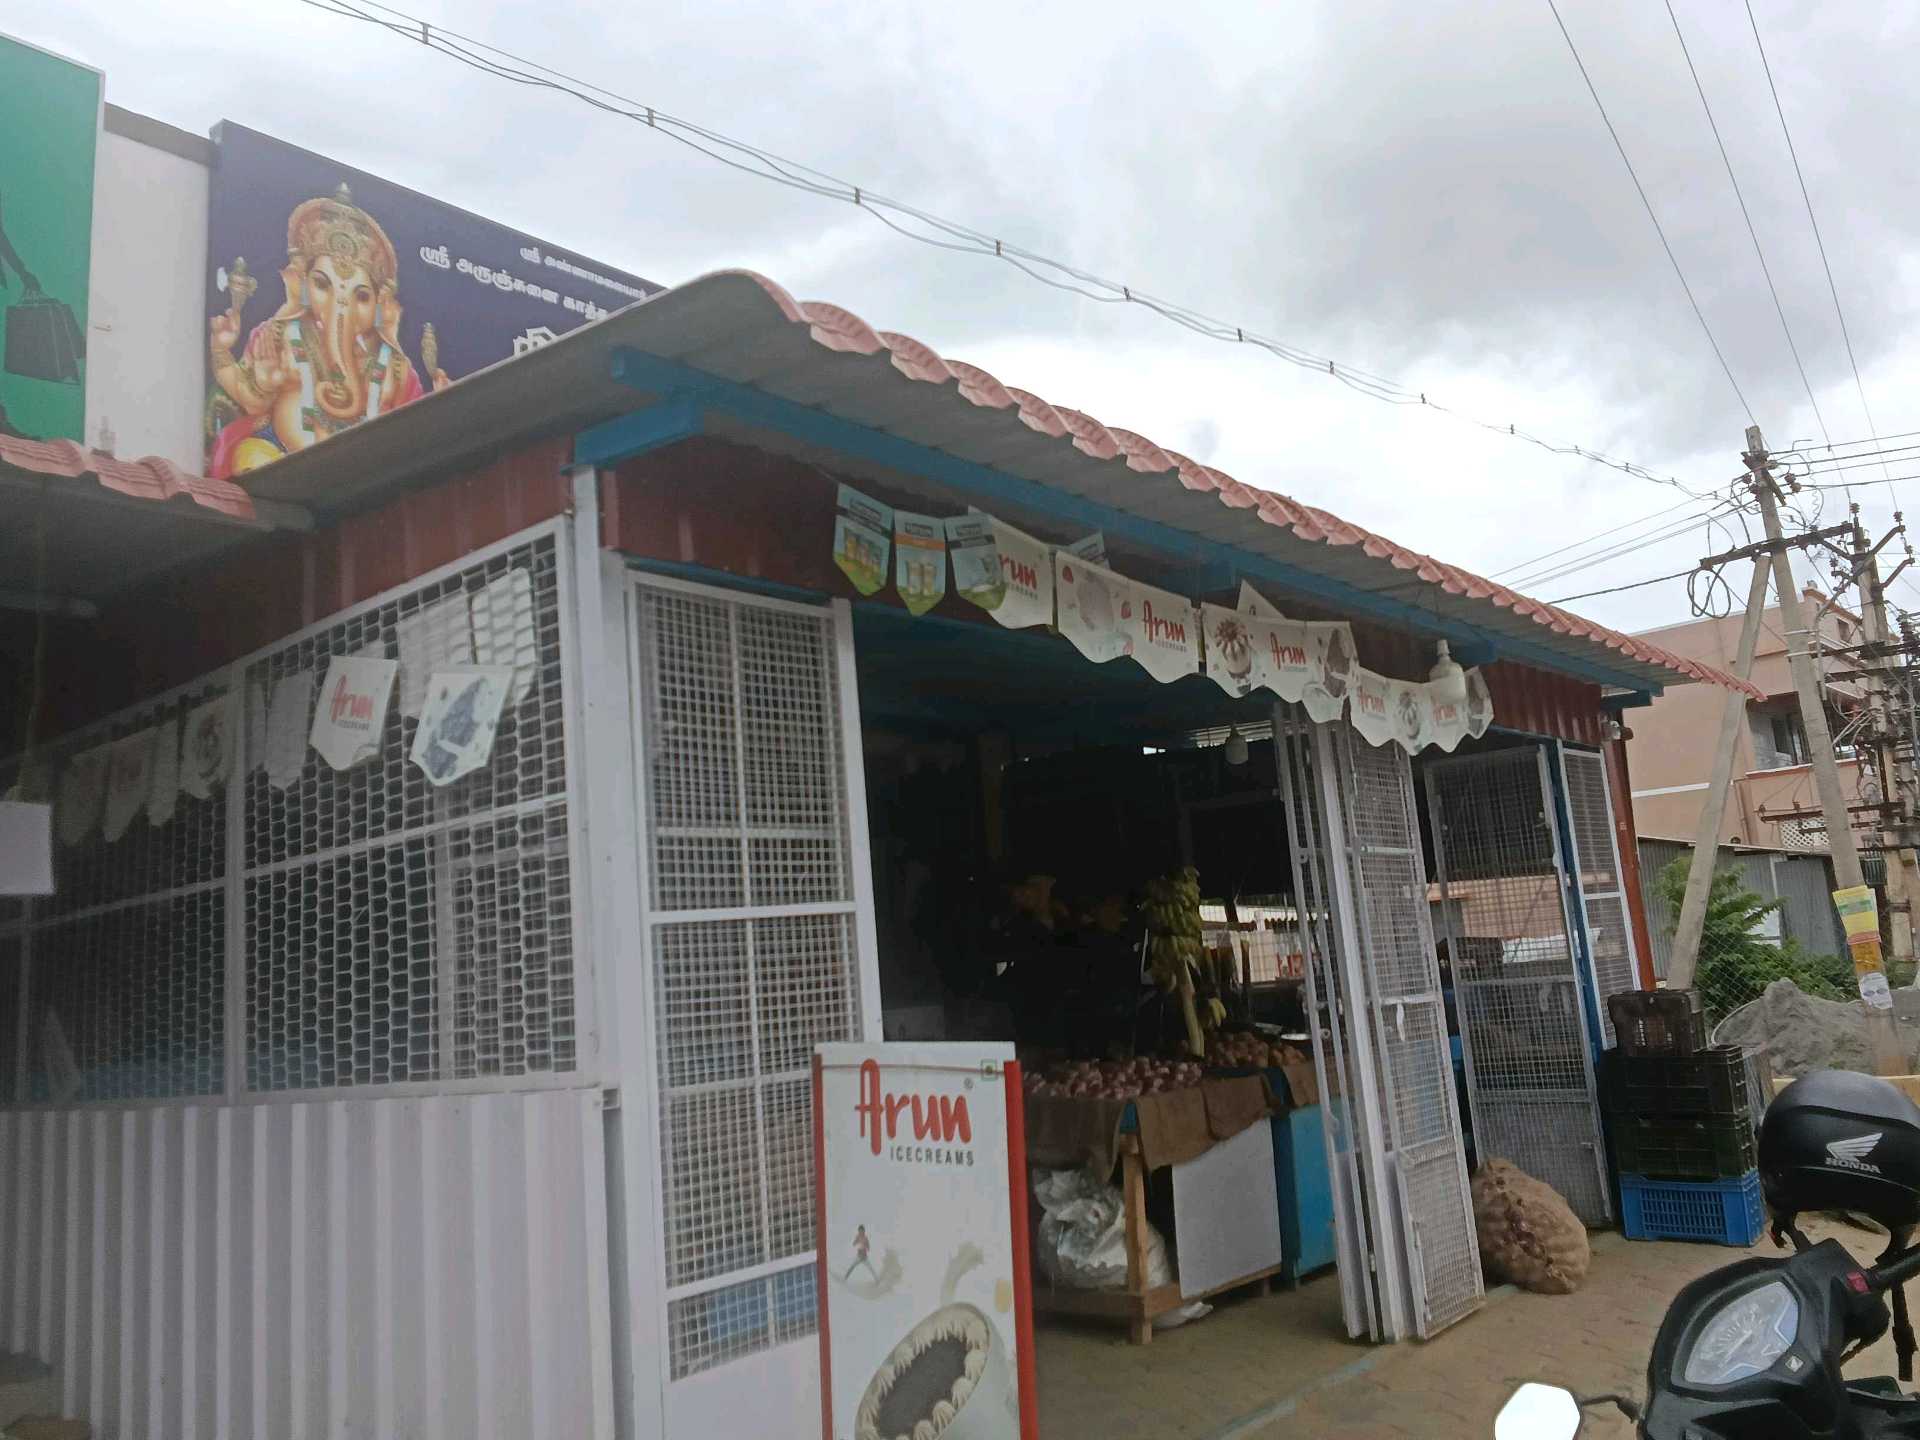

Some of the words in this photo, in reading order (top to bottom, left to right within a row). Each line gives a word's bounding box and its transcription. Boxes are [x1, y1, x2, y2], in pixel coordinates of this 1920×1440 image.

[1142, 600, 1186, 644] Arun
[1270, 631, 1306, 671] Arun
[330, 673, 375, 722] Arun
[854, 1058, 972, 1156] Arun
[890, 1145, 975, 1168] ICECREAMS
[1825, 1157, 1881, 1174] HONDA
